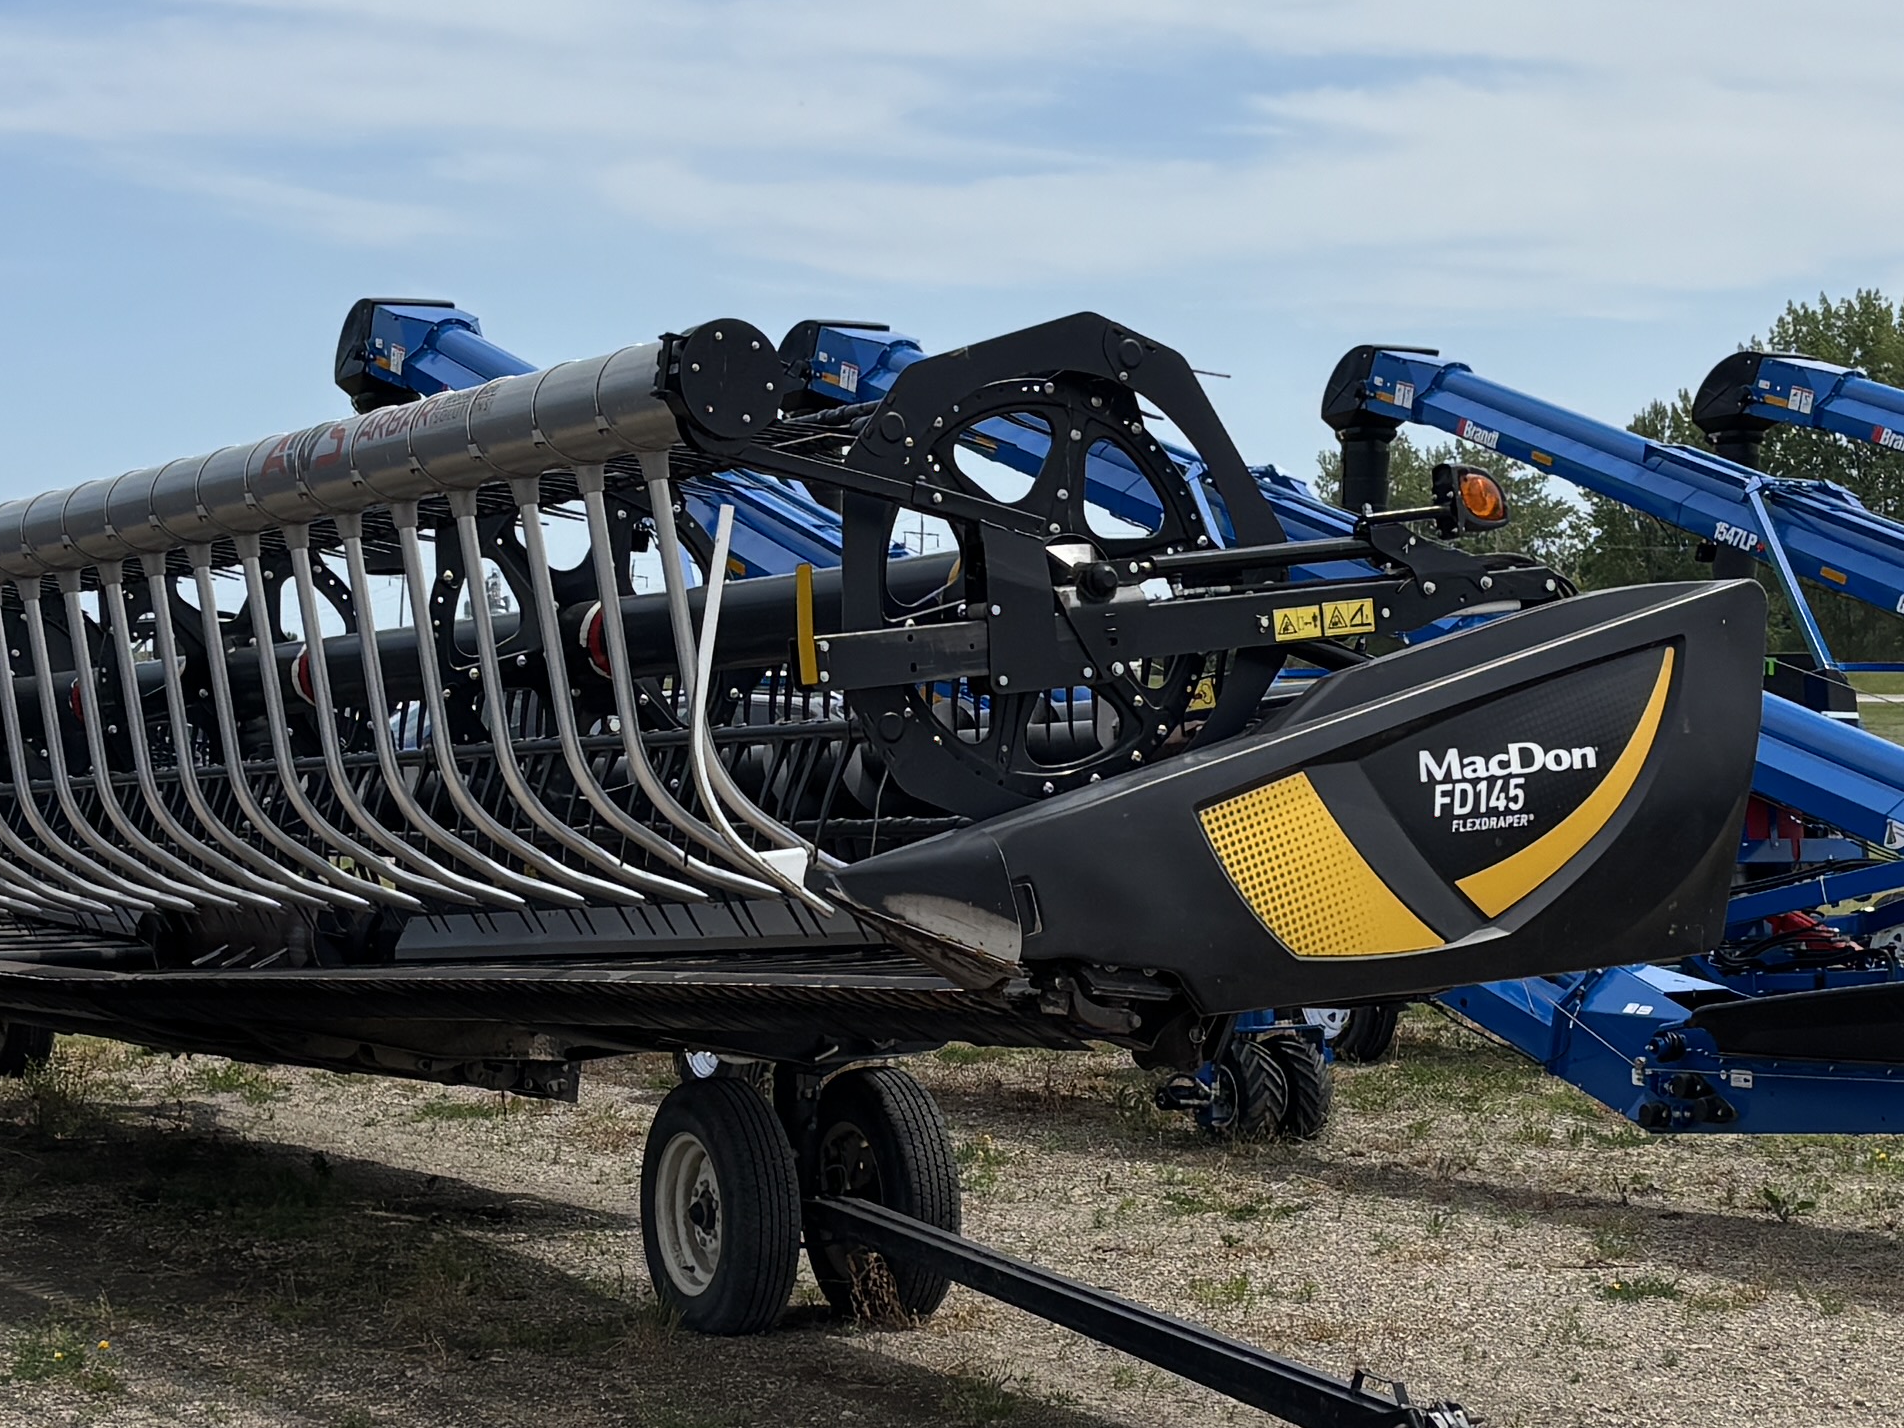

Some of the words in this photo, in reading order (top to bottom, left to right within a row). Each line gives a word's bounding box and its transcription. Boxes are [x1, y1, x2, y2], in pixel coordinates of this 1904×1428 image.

[1463, 419, 1500, 450] Brandt
[1418, 741, 1598, 783] MacDon
[1433, 777, 1526, 818] FD145
